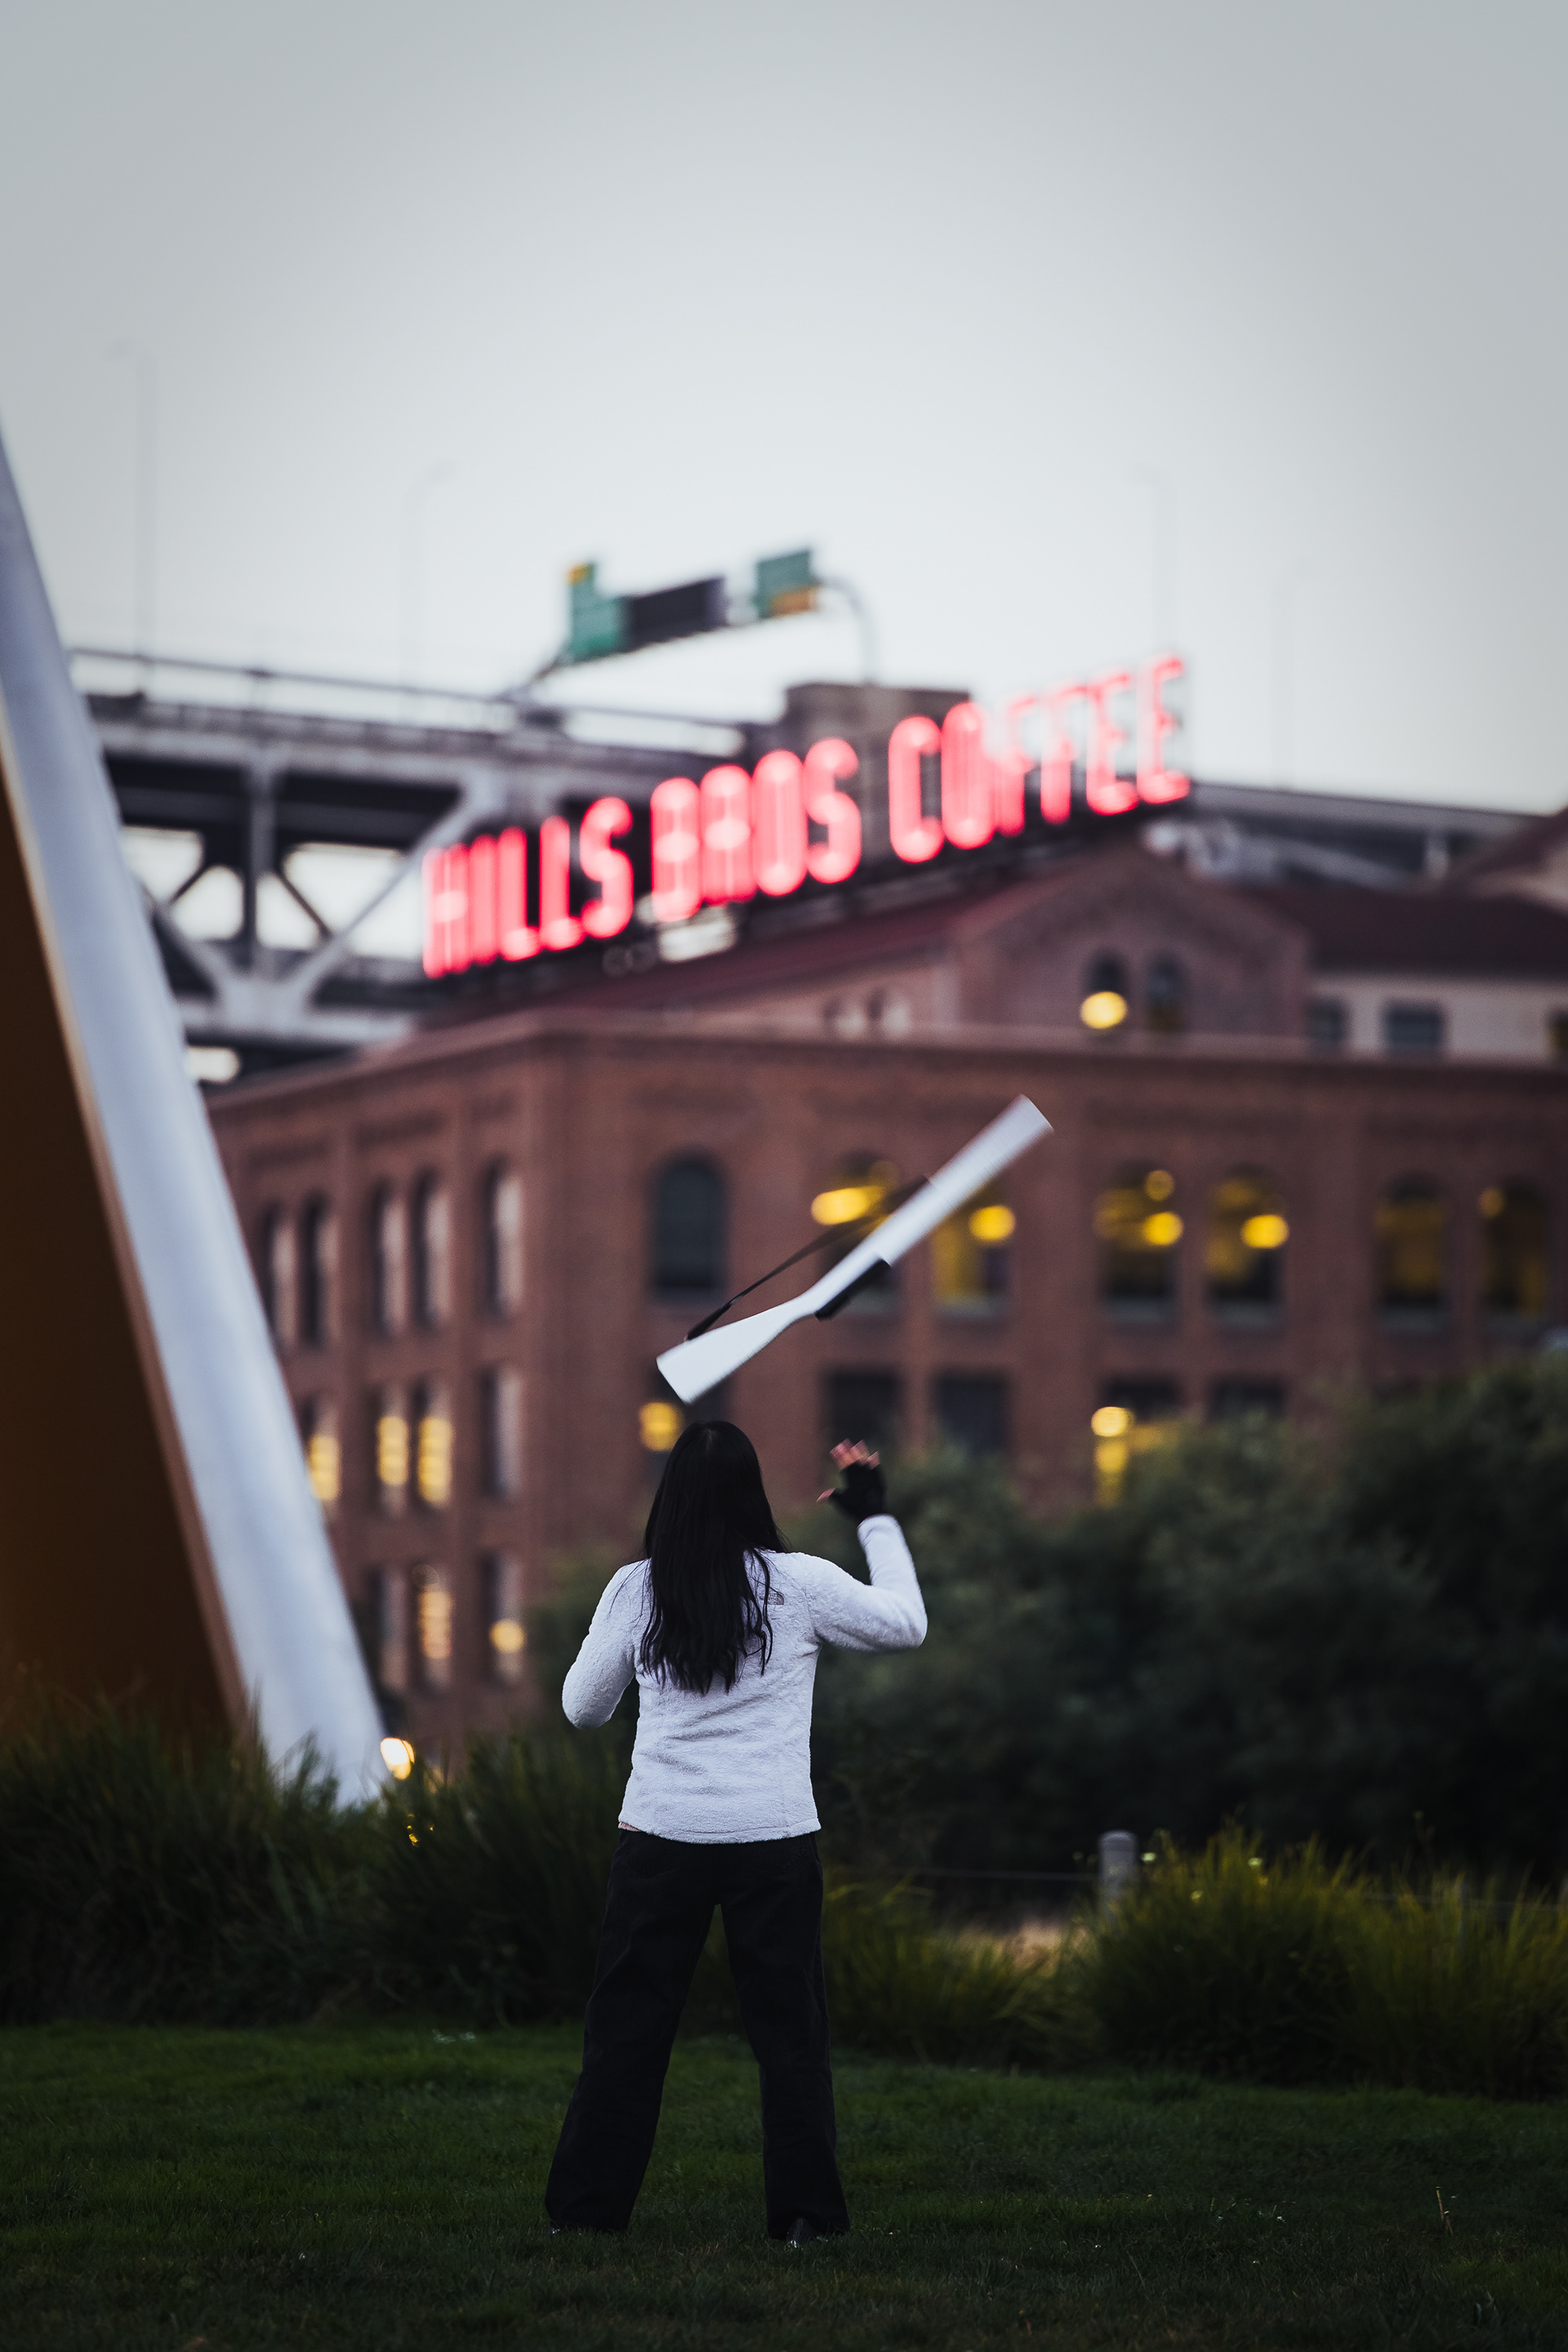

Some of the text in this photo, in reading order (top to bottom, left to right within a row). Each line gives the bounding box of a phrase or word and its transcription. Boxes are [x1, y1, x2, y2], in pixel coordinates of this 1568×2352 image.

[421, 656, 1191, 979] HILLS BROS COFFEE
